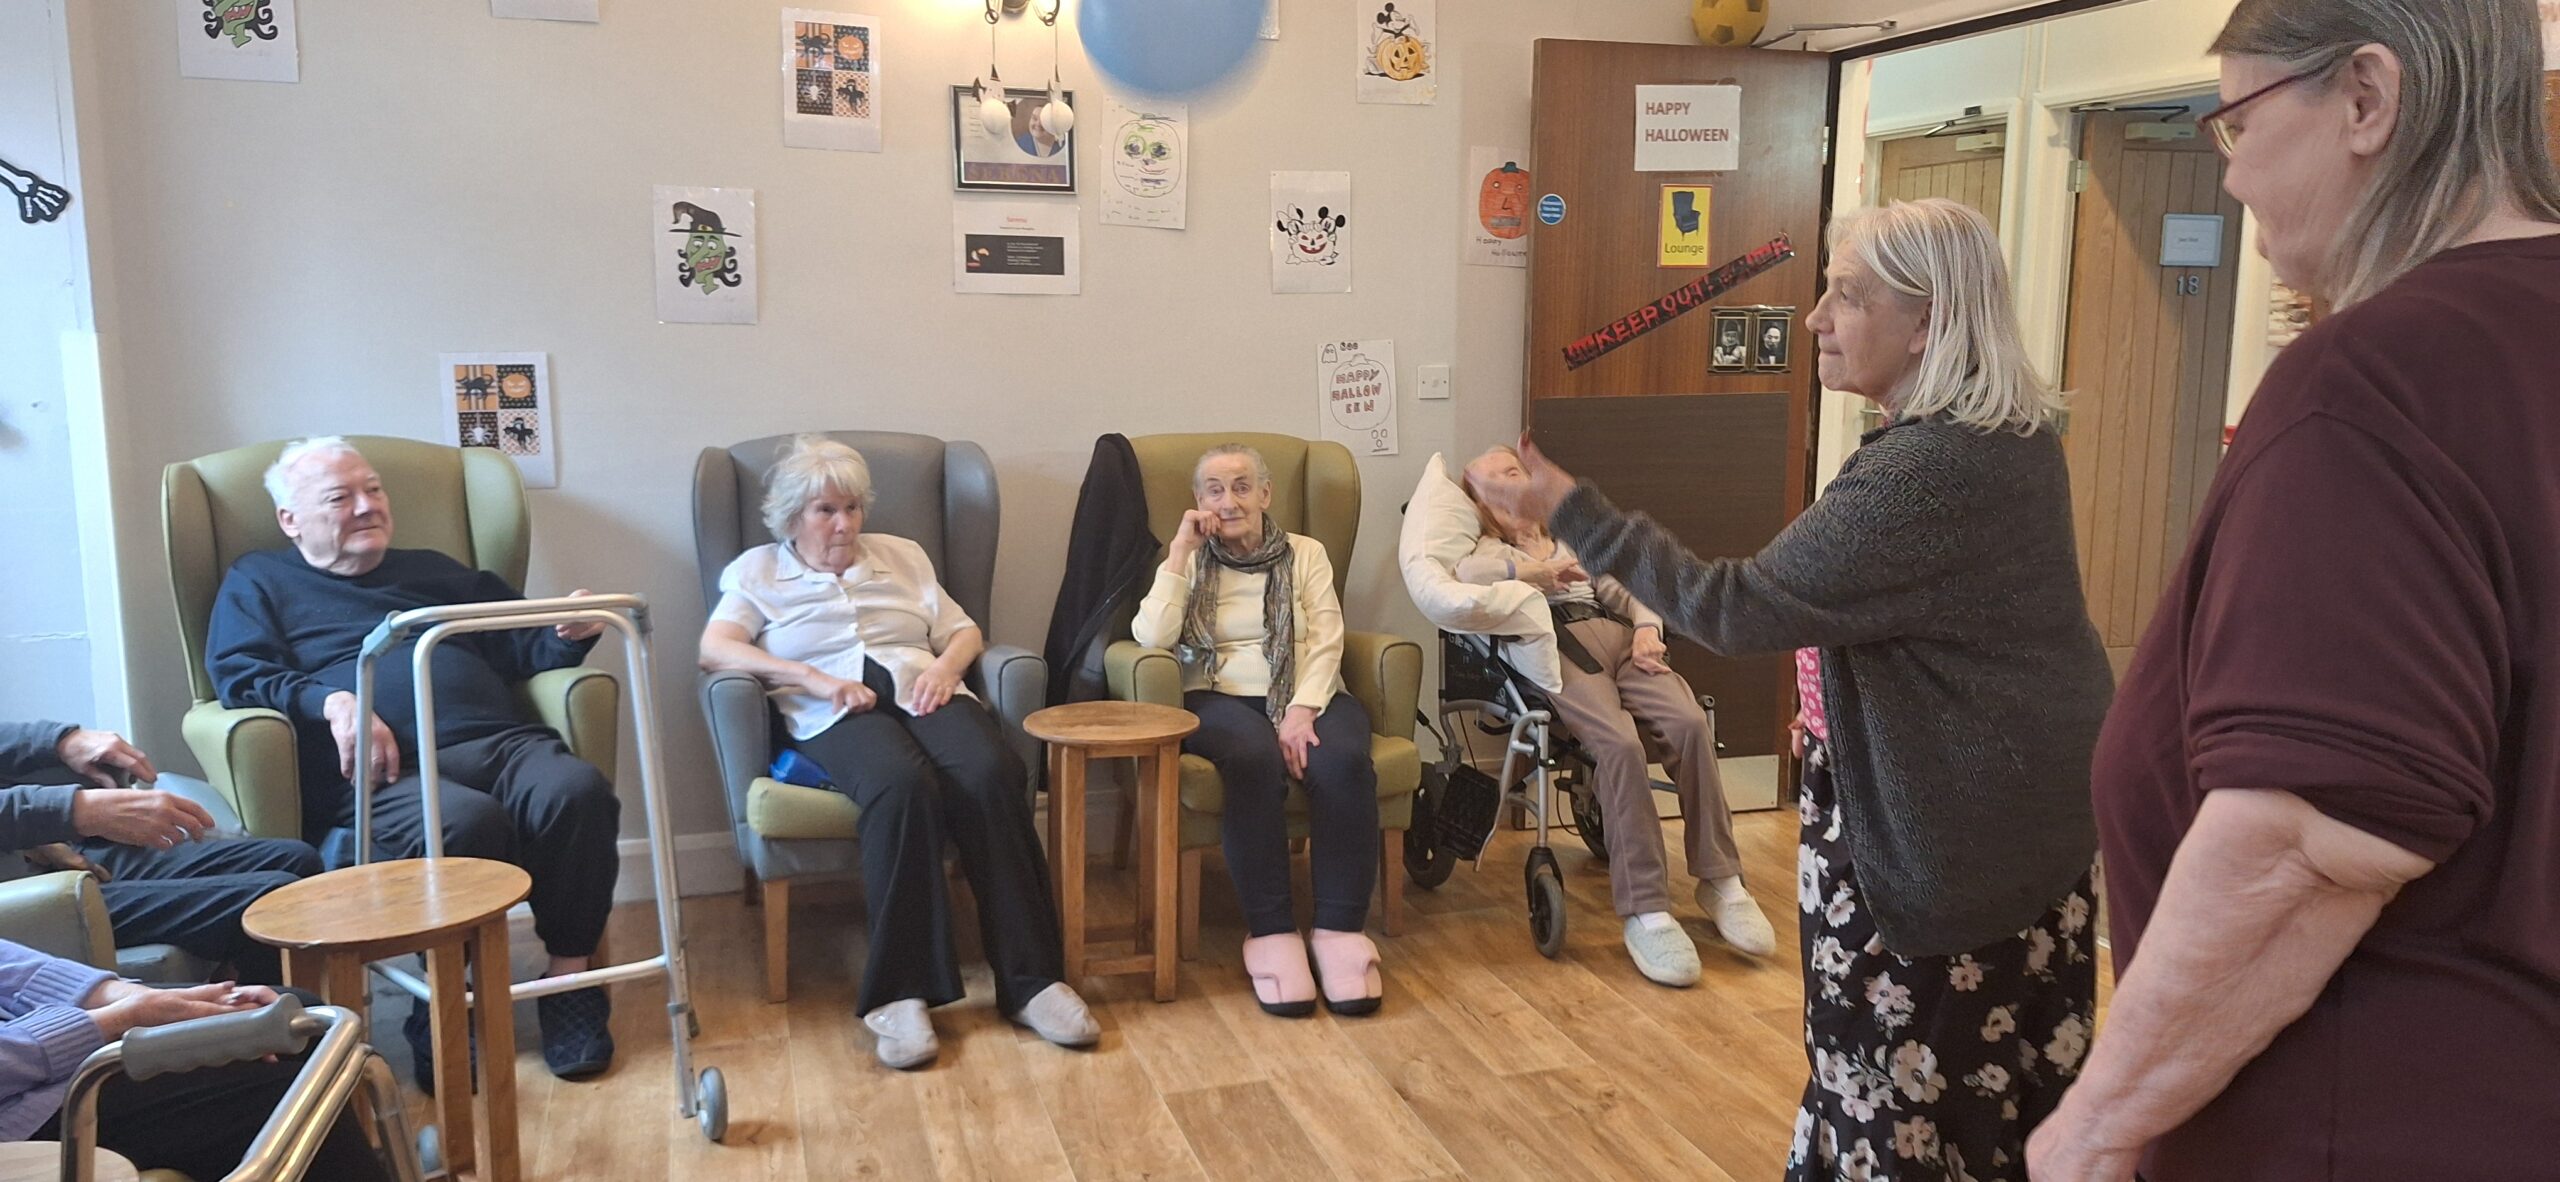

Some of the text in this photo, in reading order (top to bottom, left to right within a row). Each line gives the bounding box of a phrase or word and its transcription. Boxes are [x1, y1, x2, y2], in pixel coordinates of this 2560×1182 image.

[1645, 102, 1691, 116] HAPPY
[1645, 128, 1729, 142] HALLOWEEN
[1664, 243, 1704, 255] Lounge
[2177, 275, 2200, 296] 18
[1595, 304, 1660, 349] KEEP
[1660, 275, 1715, 313] OUT!
[1335, 369, 1380, 384] HAPPY
